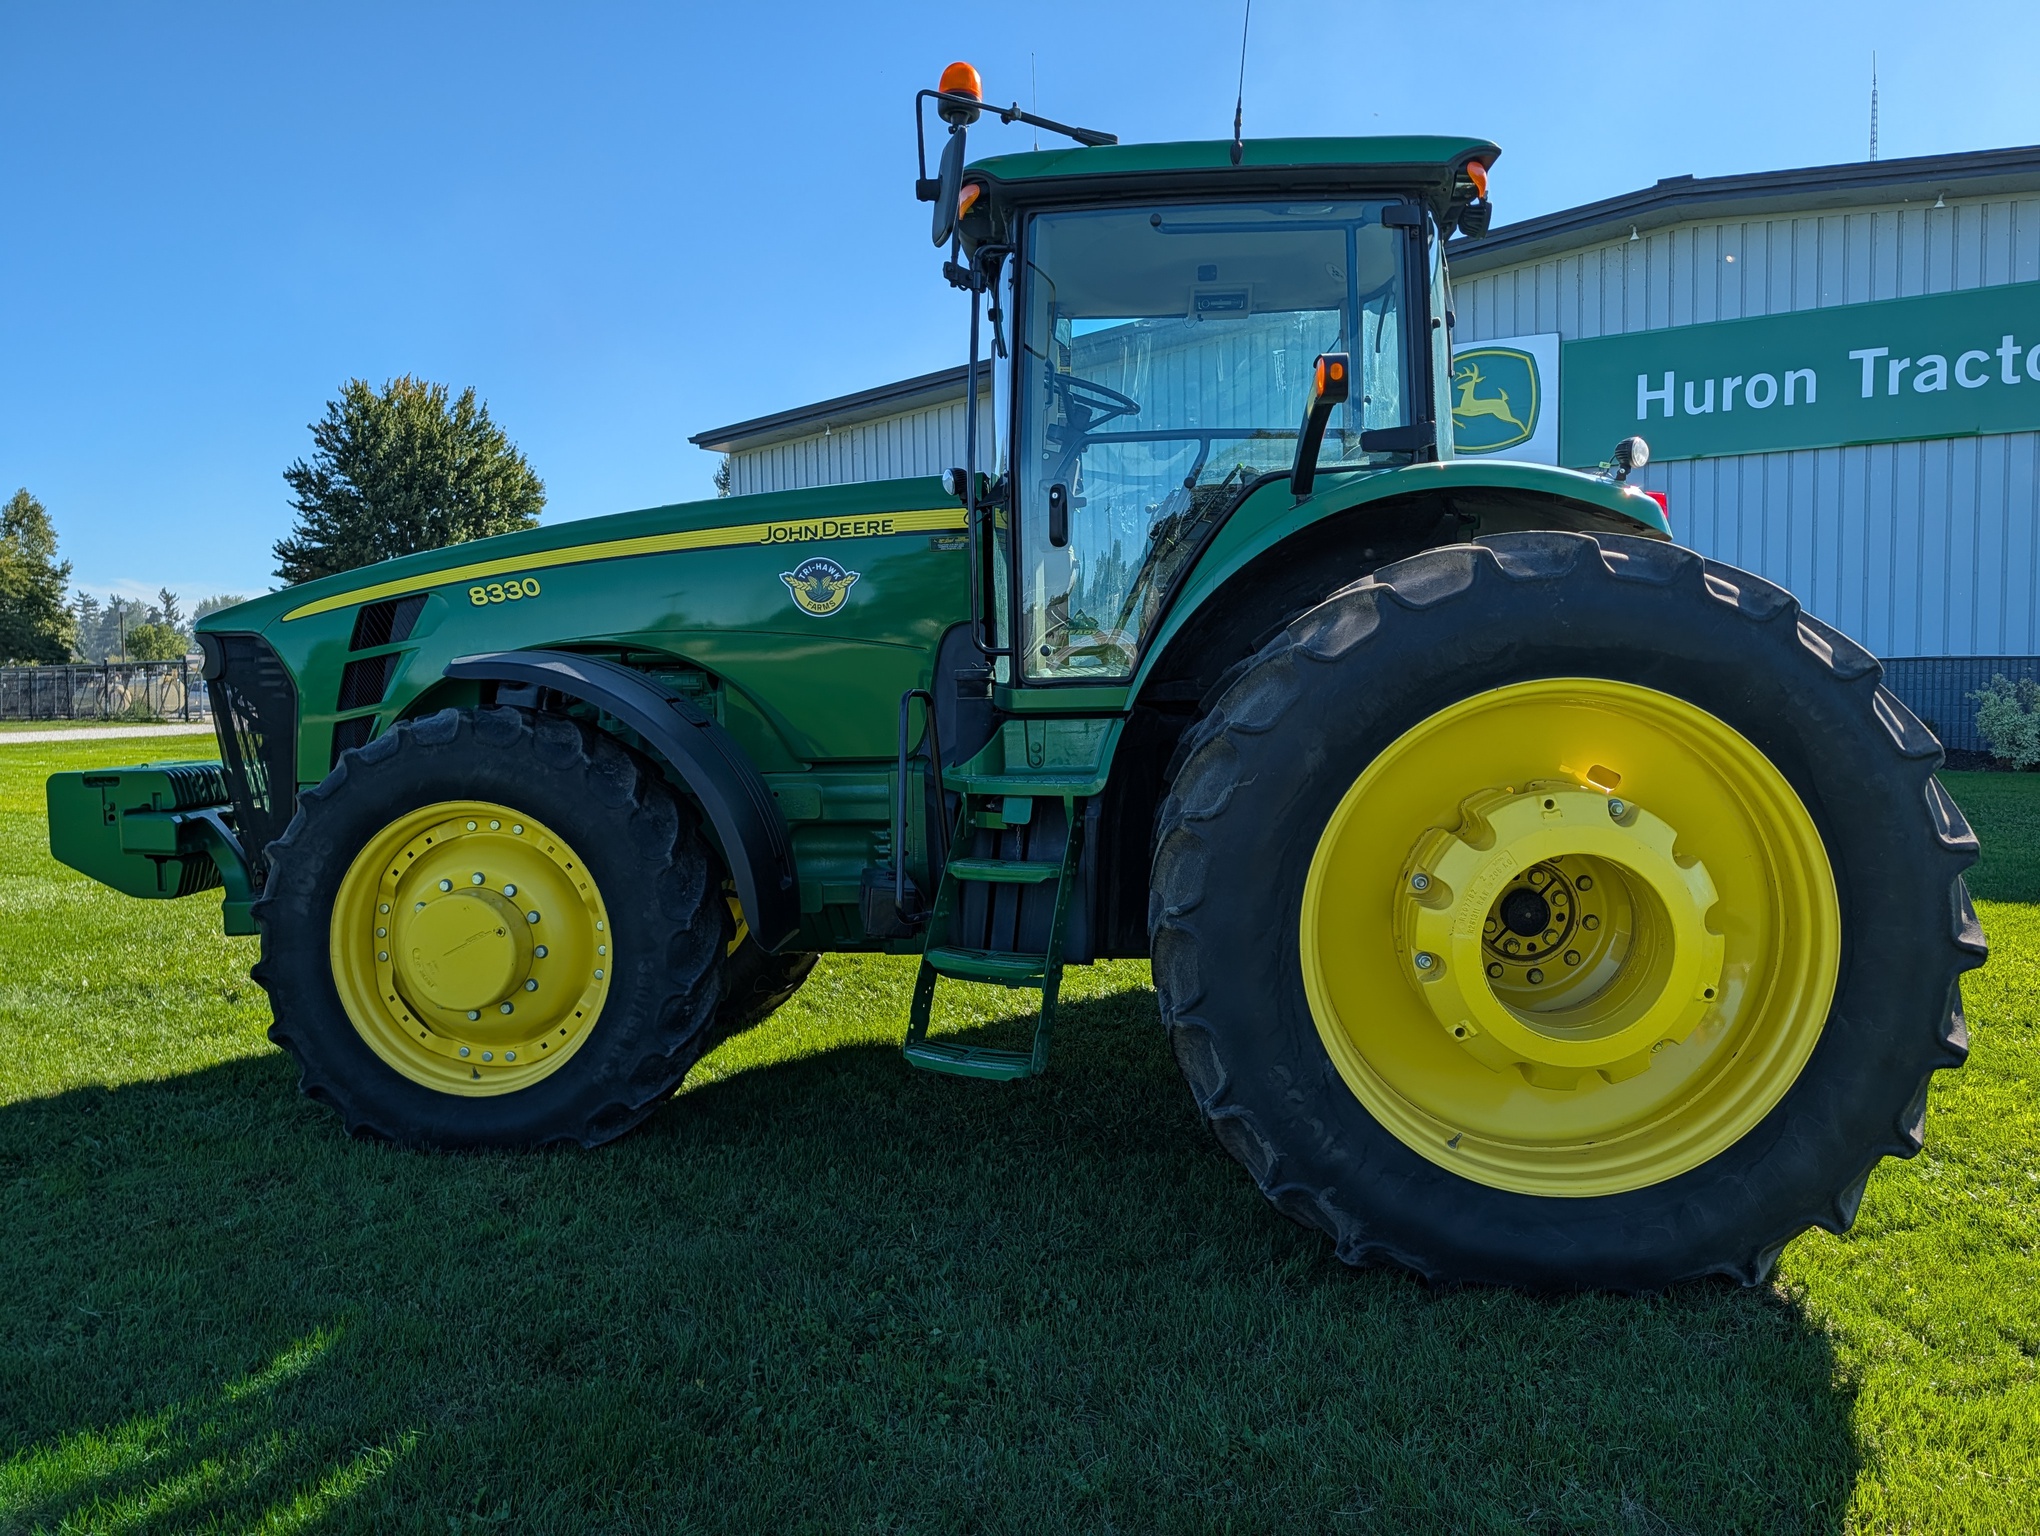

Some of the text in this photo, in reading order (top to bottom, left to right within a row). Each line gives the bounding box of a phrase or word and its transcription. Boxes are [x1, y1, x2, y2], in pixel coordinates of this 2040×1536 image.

[1637, 368, 1817, 420] Huron
[760, 519, 895, 544] JOHN DEERE
[798, 562, 841, 580] TRI-HAWK
[468, 578, 541, 606] 8330
[806, 600, 836, 611] FARMS
